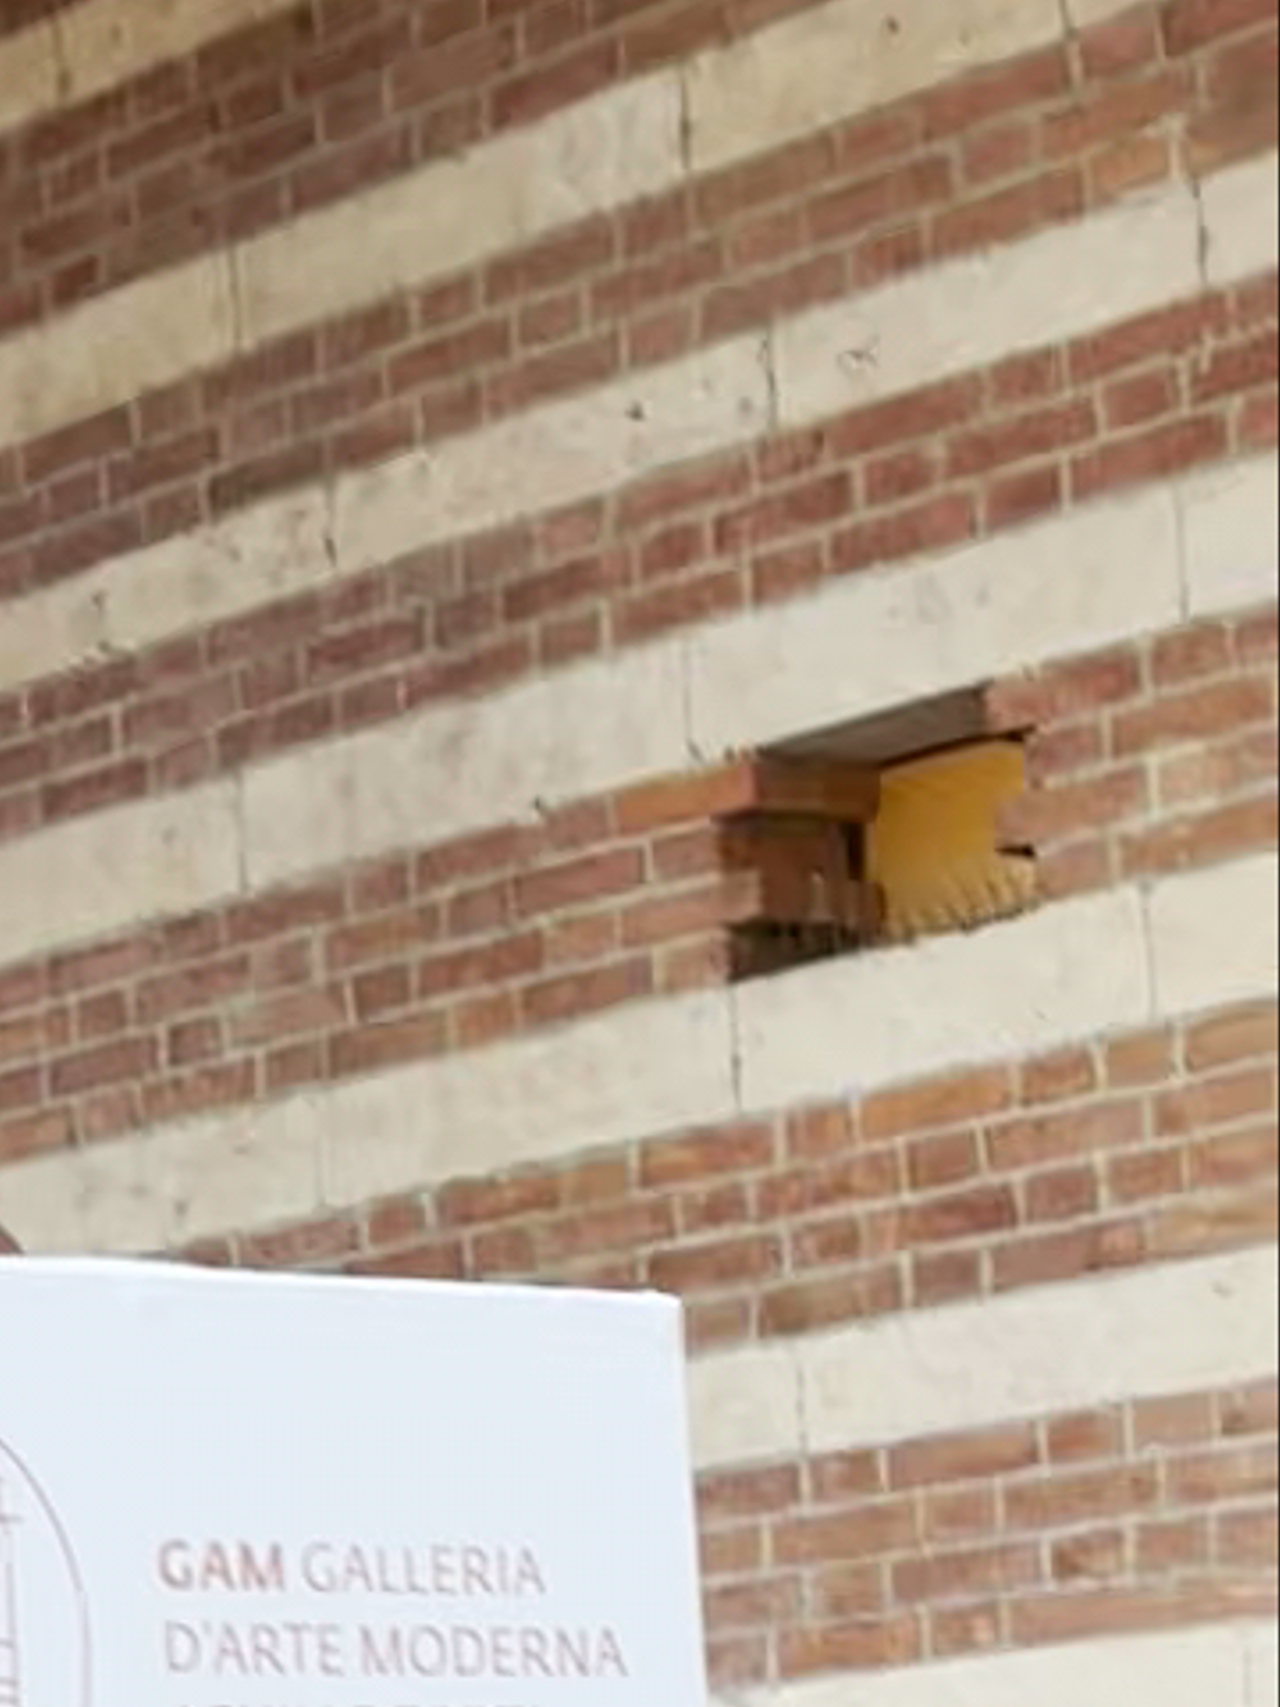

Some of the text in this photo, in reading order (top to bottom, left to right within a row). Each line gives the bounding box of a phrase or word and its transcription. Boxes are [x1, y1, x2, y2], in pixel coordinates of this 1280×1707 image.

[157, 1537, 547, 1595] GAM GALLERIA
[163, 1620, 629, 1678] D'ARTE MODERNA
